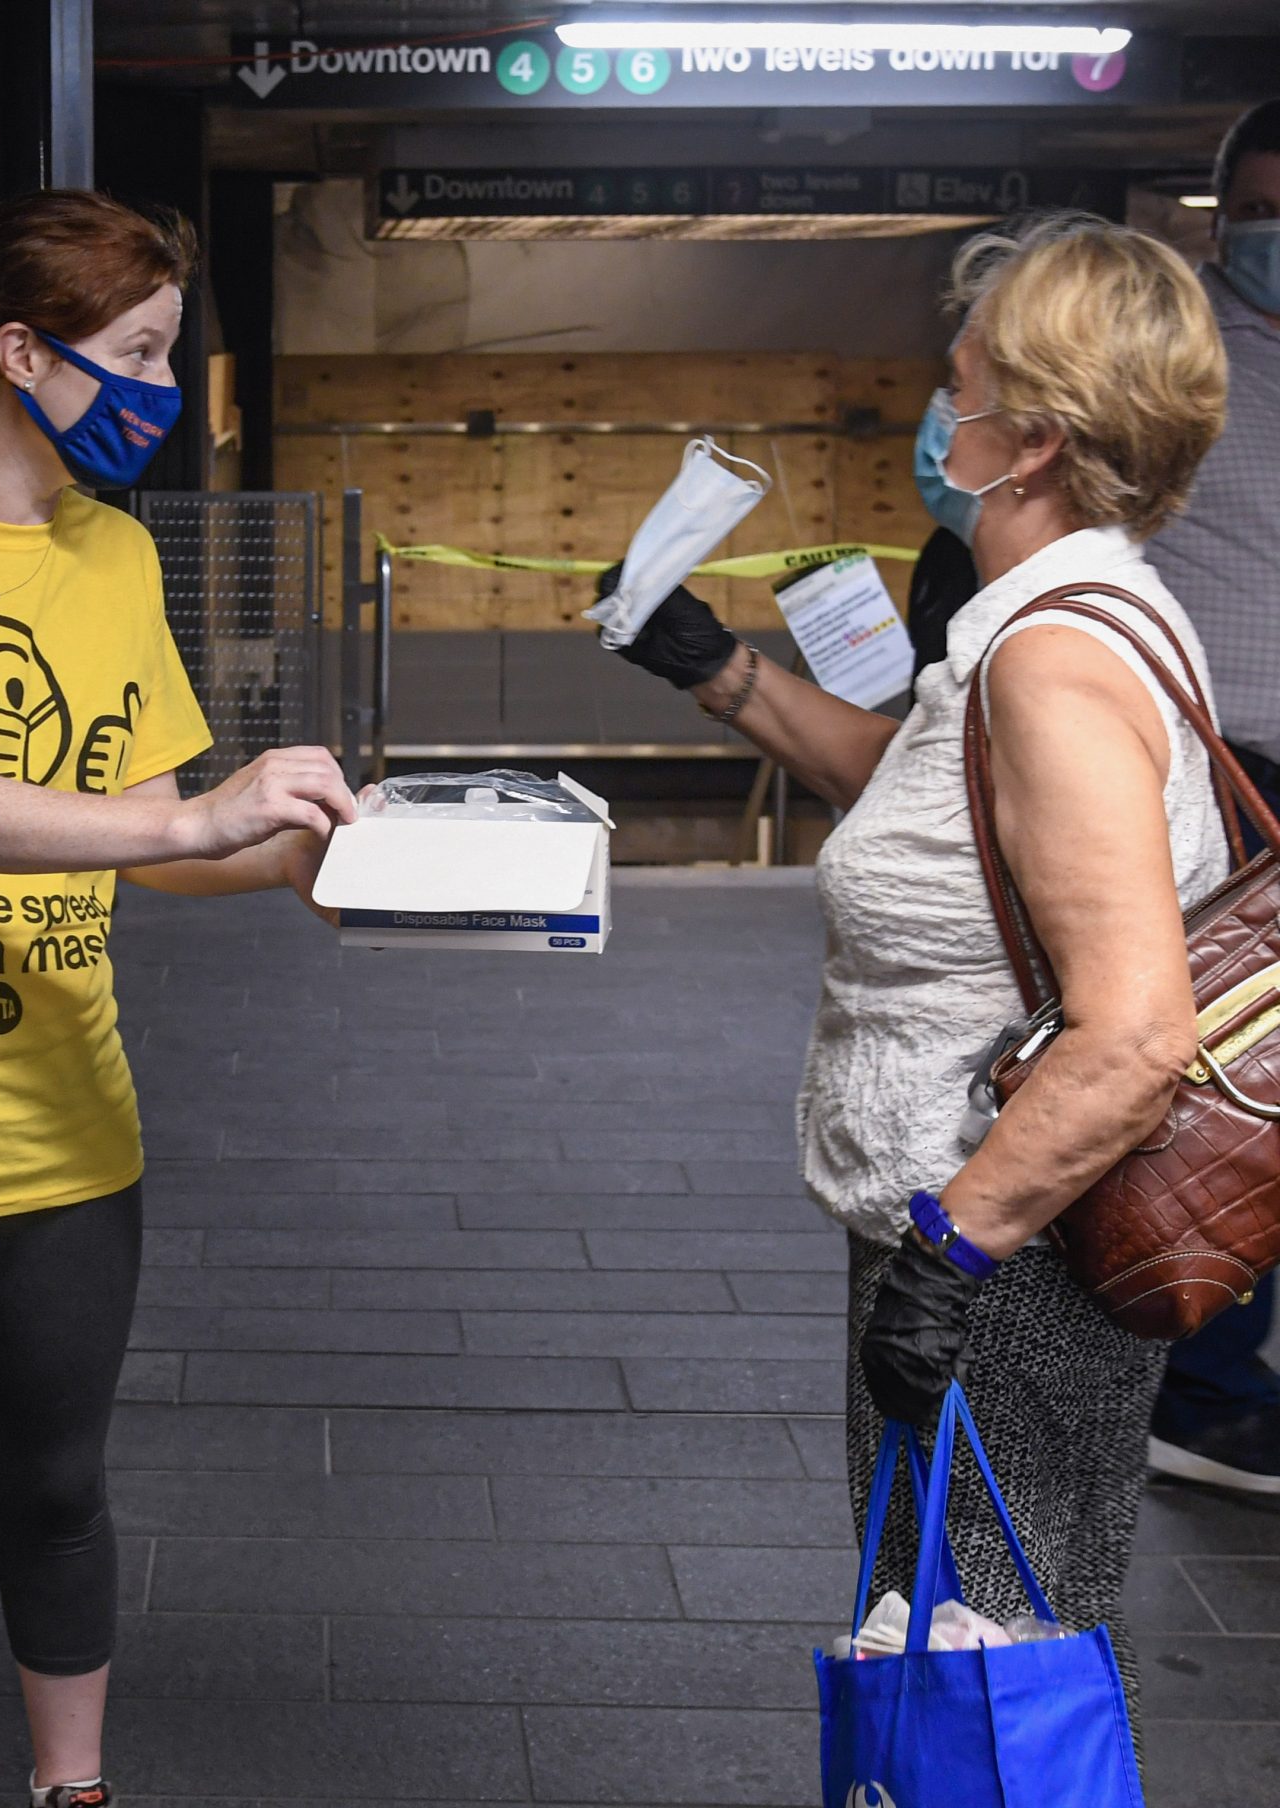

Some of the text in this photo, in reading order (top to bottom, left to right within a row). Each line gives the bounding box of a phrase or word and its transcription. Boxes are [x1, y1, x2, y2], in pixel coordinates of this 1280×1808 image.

[290, 40, 491, 73] Downtown
[508, 53, 533, 82] 4
[571, 53, 595, 83] 5
[629, 52, 656, 83] 6
[424, 174, 575, 200] Downtown
[393, 911, 548, 929] Disposable Face Mask
[563, 937, 581, 947] PCS
